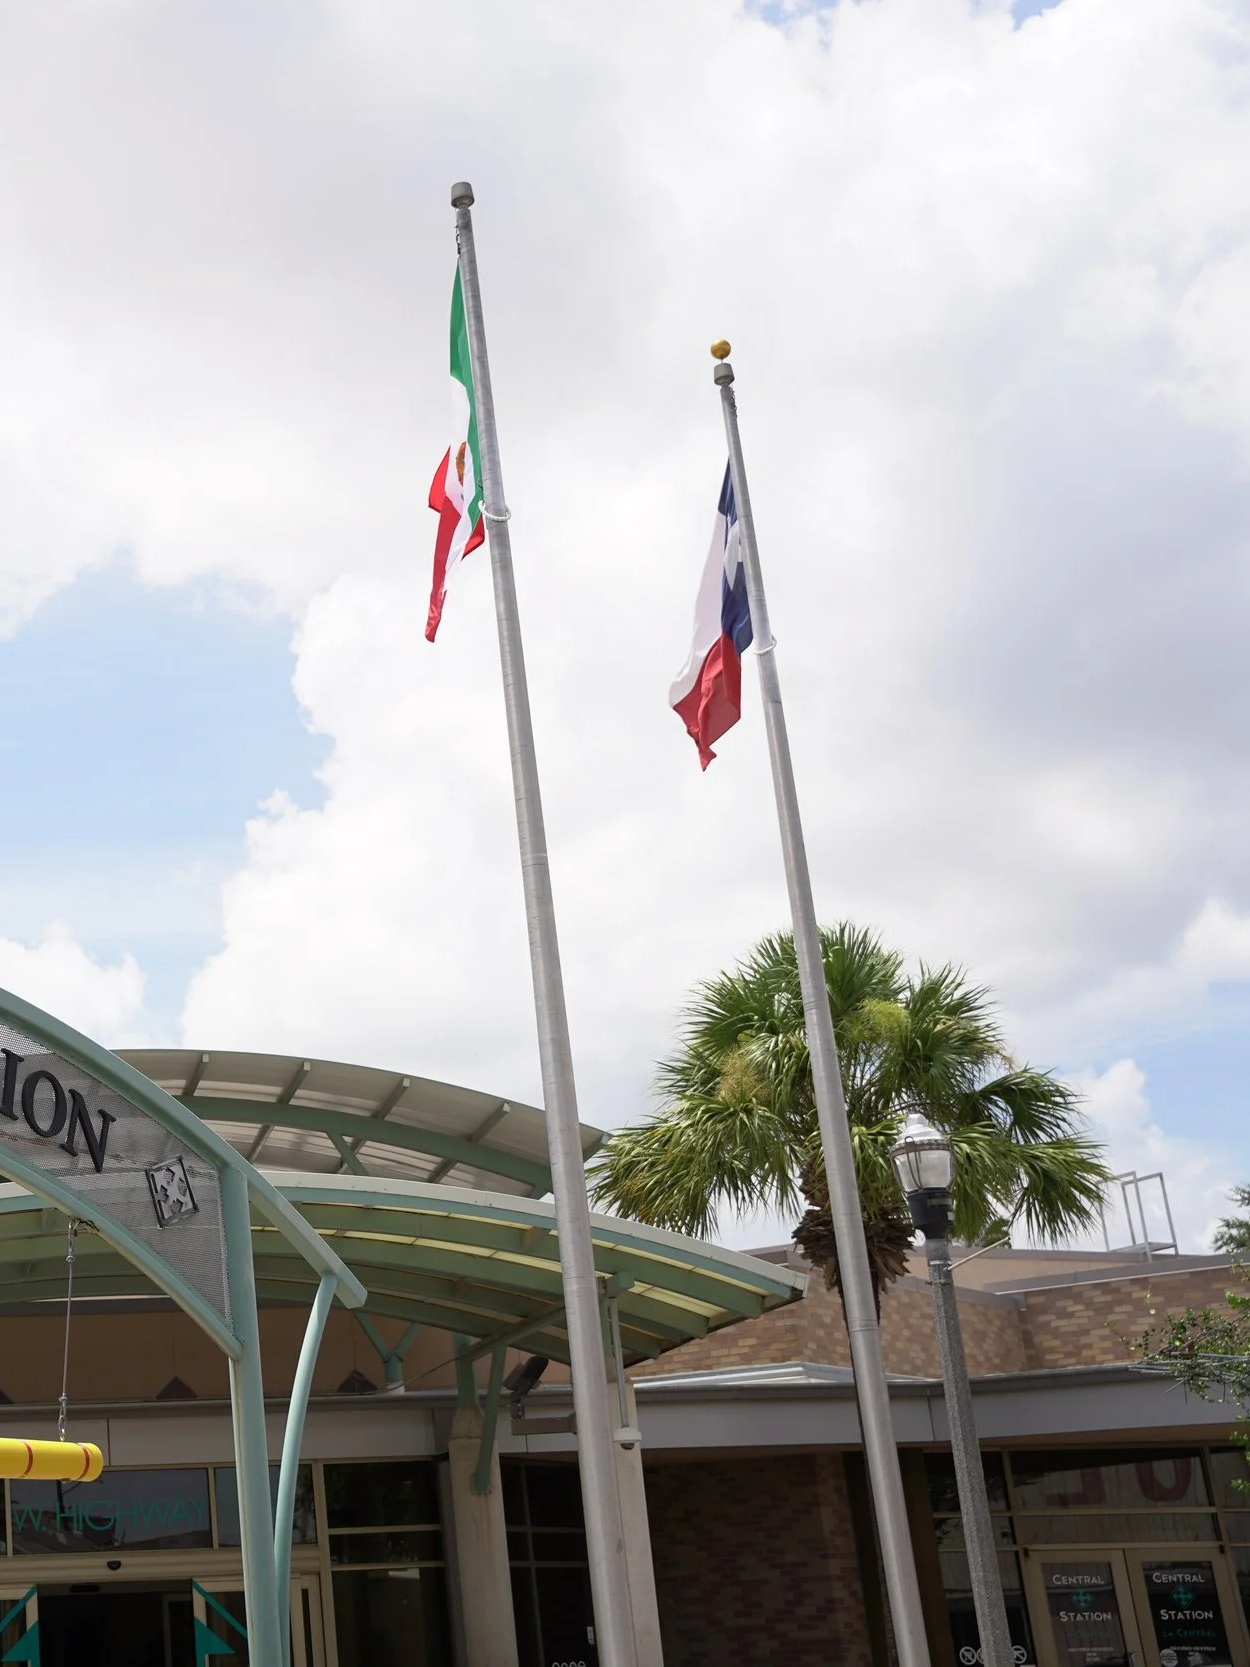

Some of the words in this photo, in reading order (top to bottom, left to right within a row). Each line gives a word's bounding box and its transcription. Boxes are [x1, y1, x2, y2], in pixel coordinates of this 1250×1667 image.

[56, 1496, 209, 1533] HIGHWAY
[1053, 1574, 1106, 1585] CENTRAL
[1152, 1572, 1206, 1584] CENTRAL
[1059, 1610, 1112, 1622] STATION
[1159, 1608, 1213, 1621] STATION
